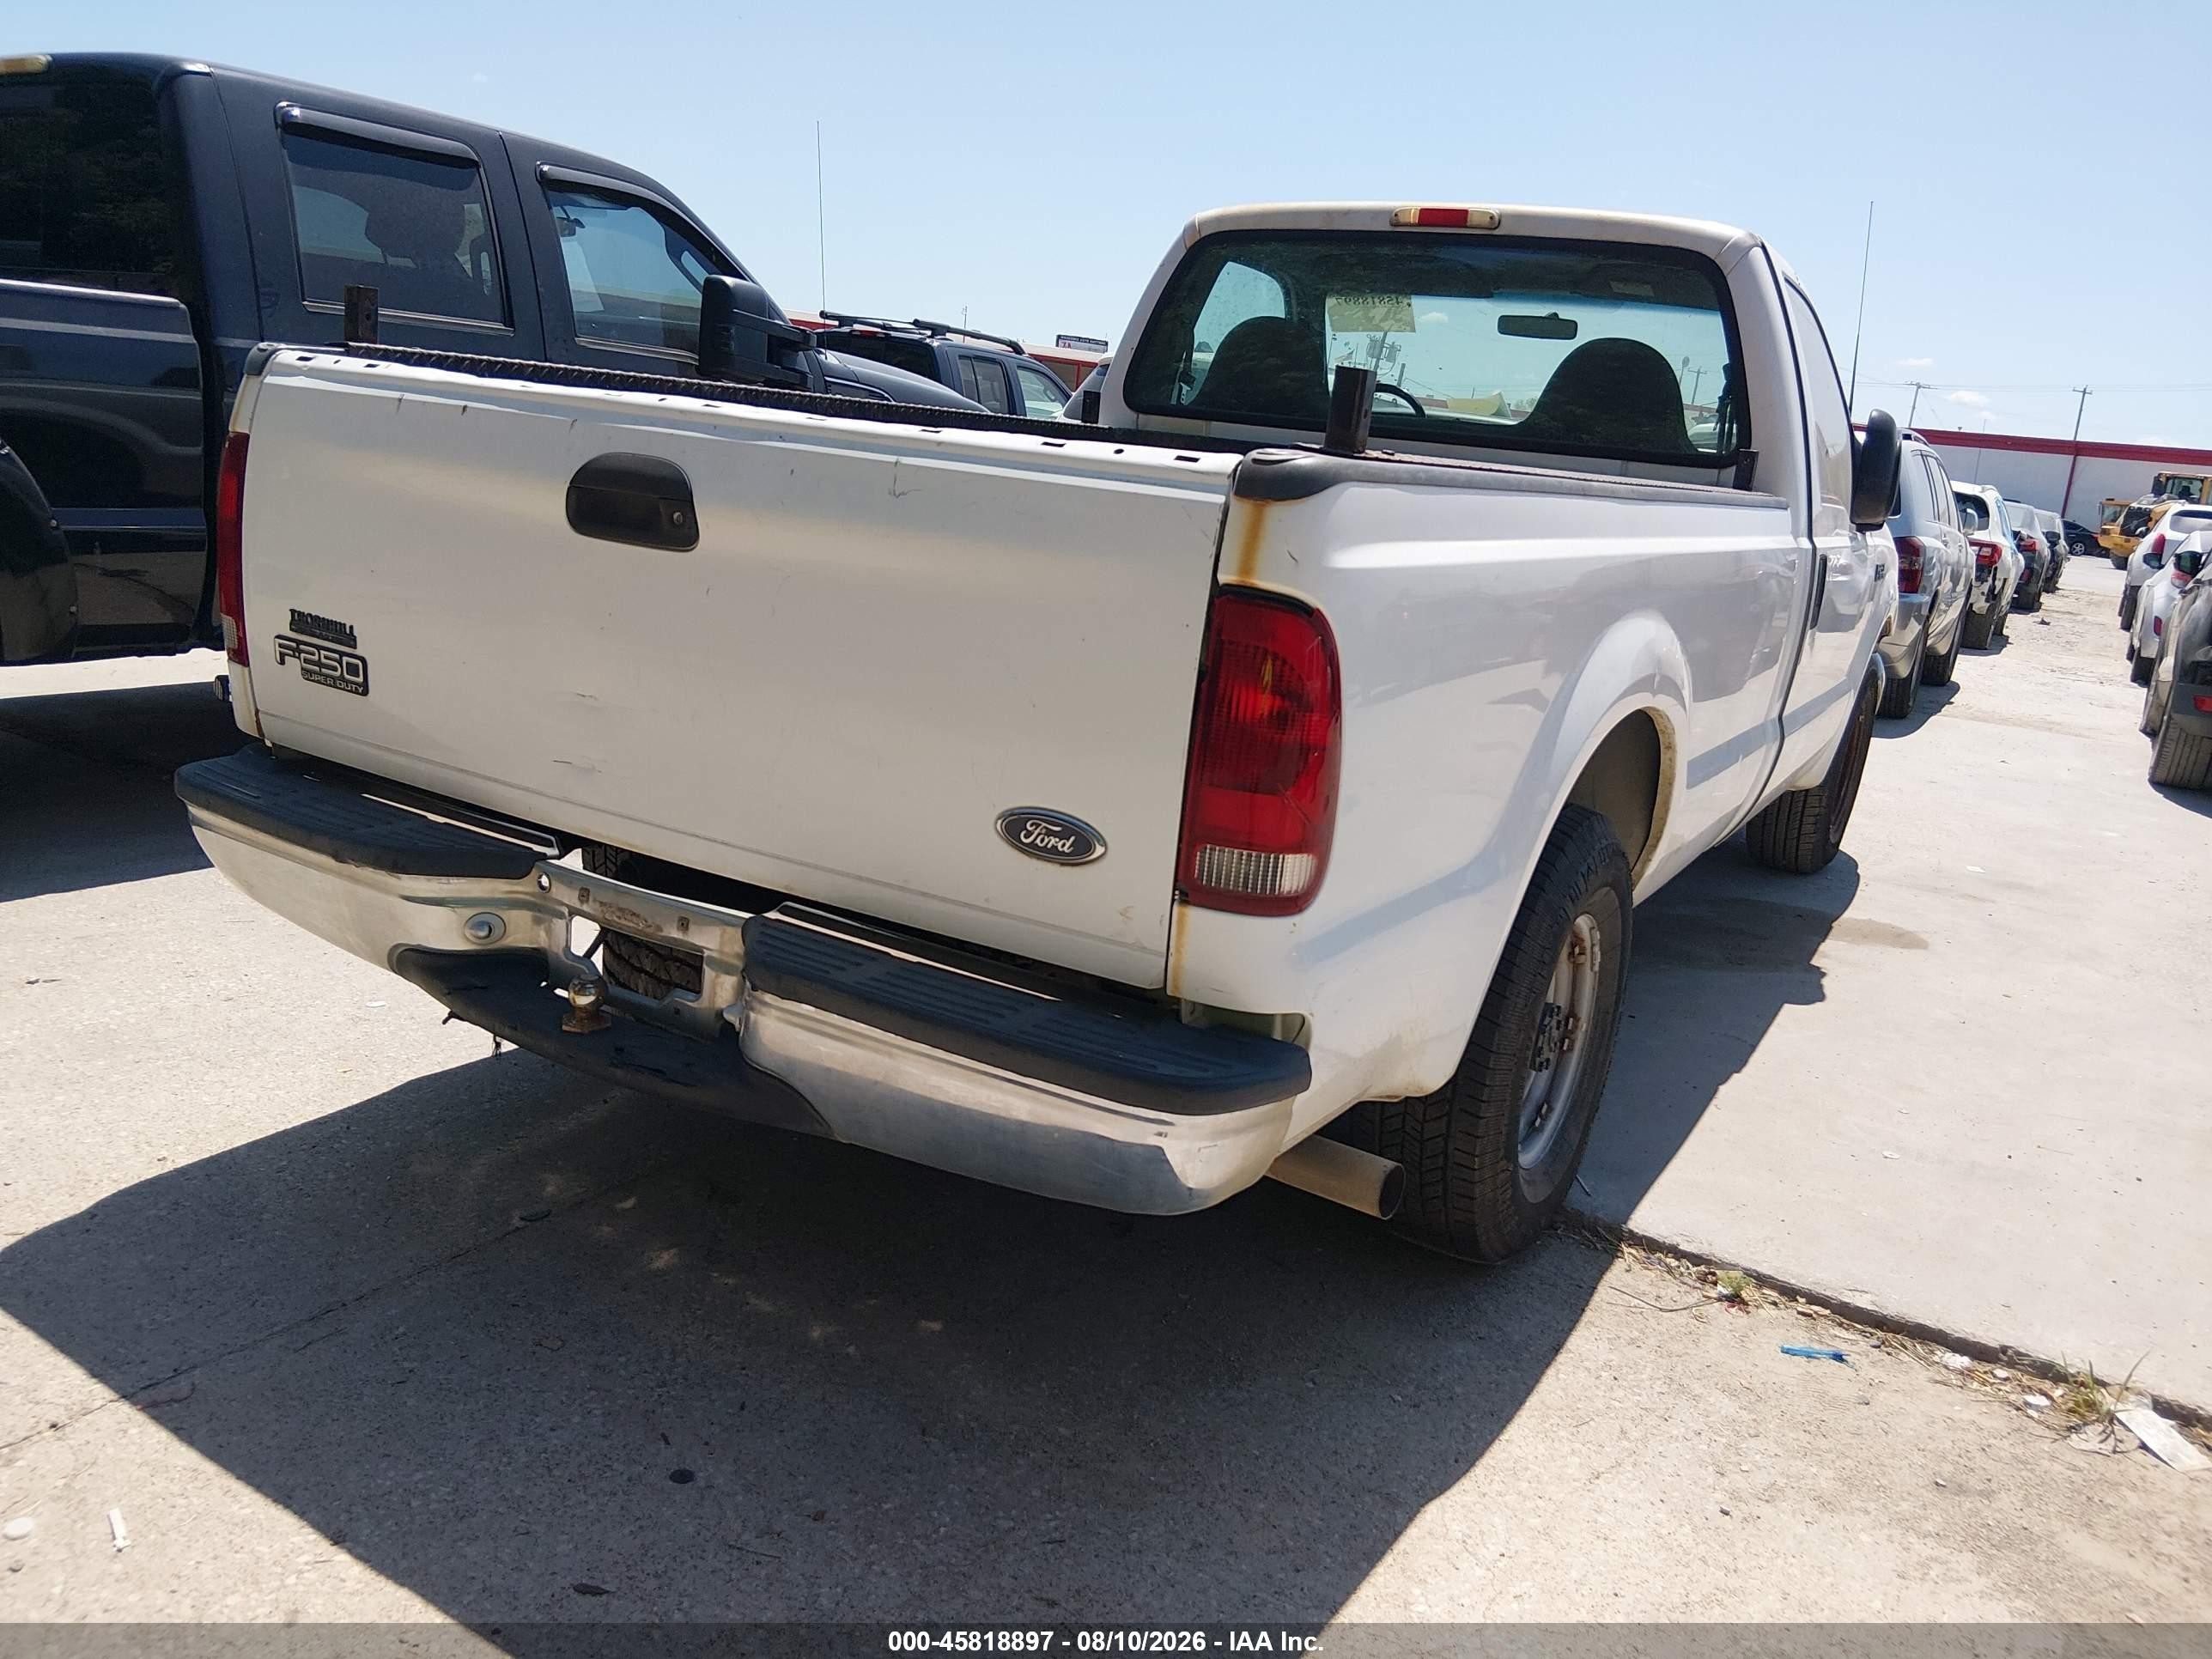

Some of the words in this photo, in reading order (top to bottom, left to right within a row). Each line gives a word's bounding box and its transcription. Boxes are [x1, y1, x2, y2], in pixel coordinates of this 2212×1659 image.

[301, 670, 334, 686] SUPER
[336, 679, 364, 693] DUTY
[1019, 819, 1076, 854] Ford
